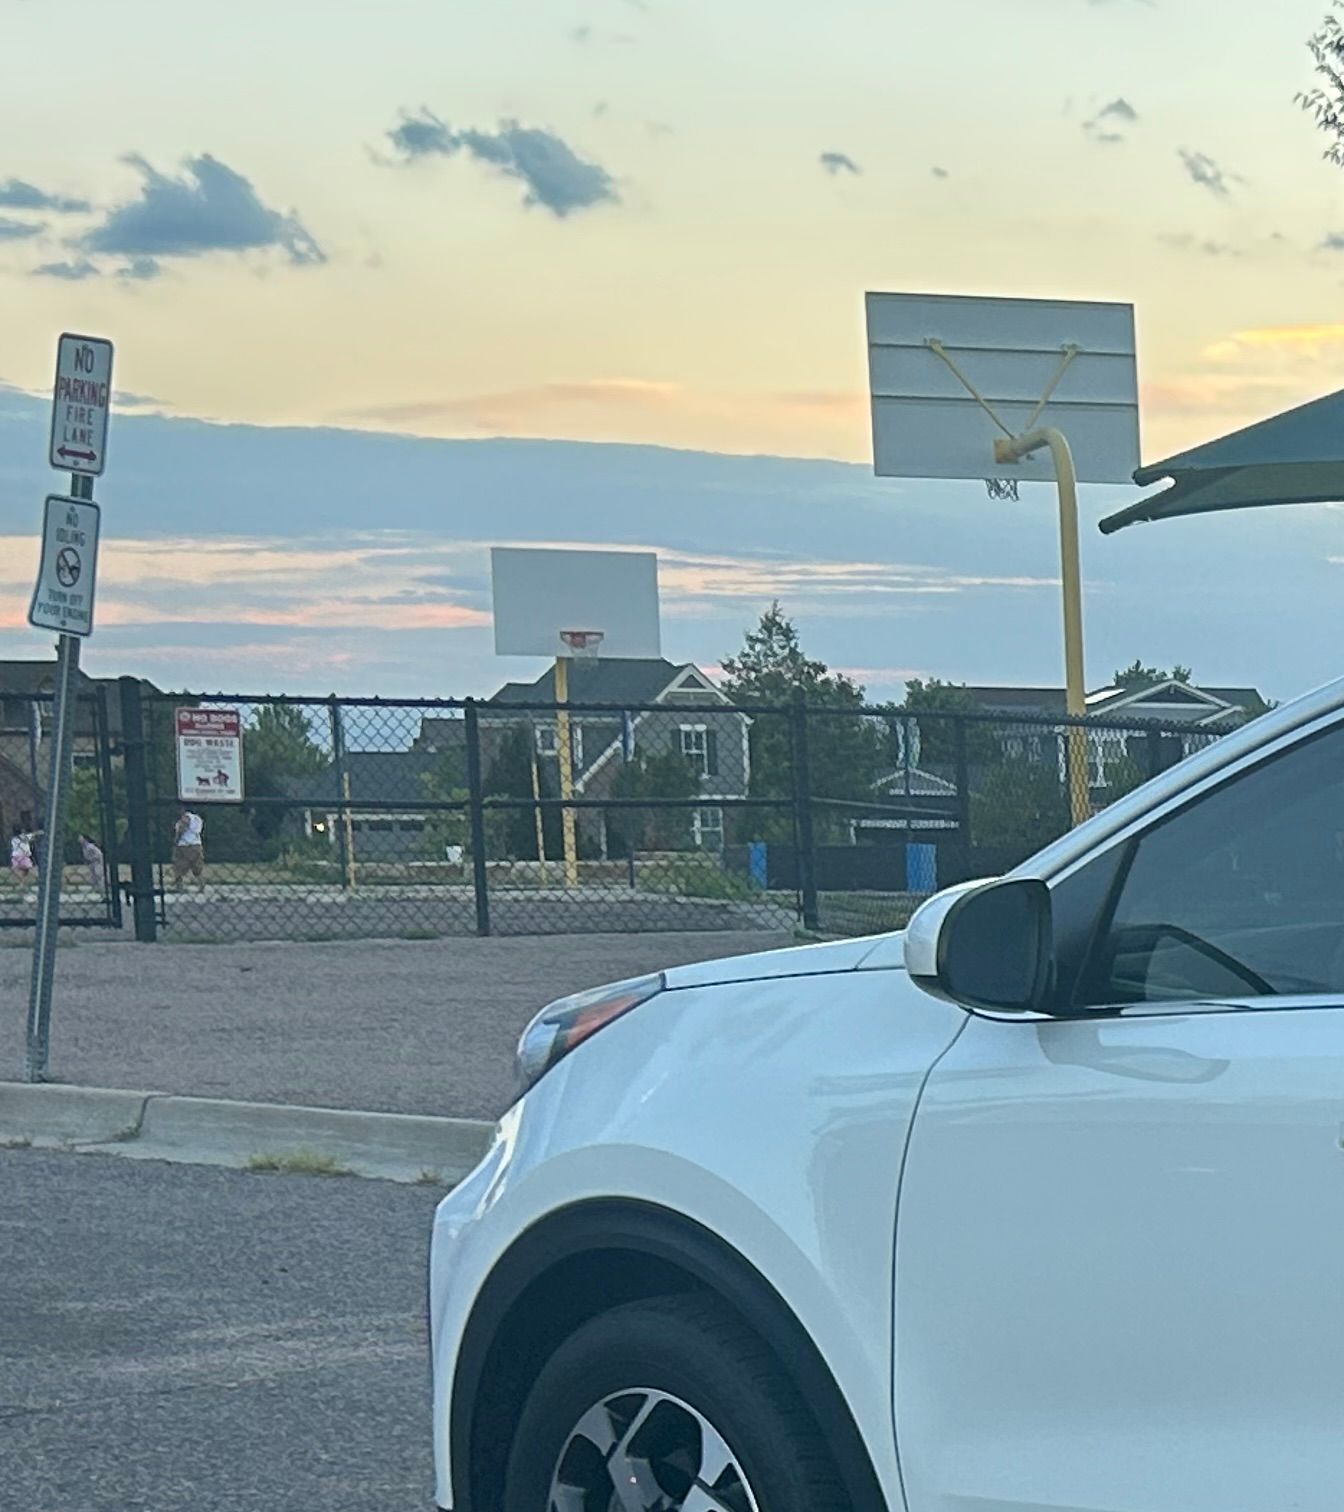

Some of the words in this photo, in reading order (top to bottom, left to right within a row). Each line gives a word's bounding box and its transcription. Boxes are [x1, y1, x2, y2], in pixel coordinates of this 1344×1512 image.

[74, 346, 95, 374] NO
[59, 375, 107, 408] PARKING
[66, 404, 95, 426] FIRE
[63, 424, 94, 447] LANE
[66, 511, 80, 529] NO
